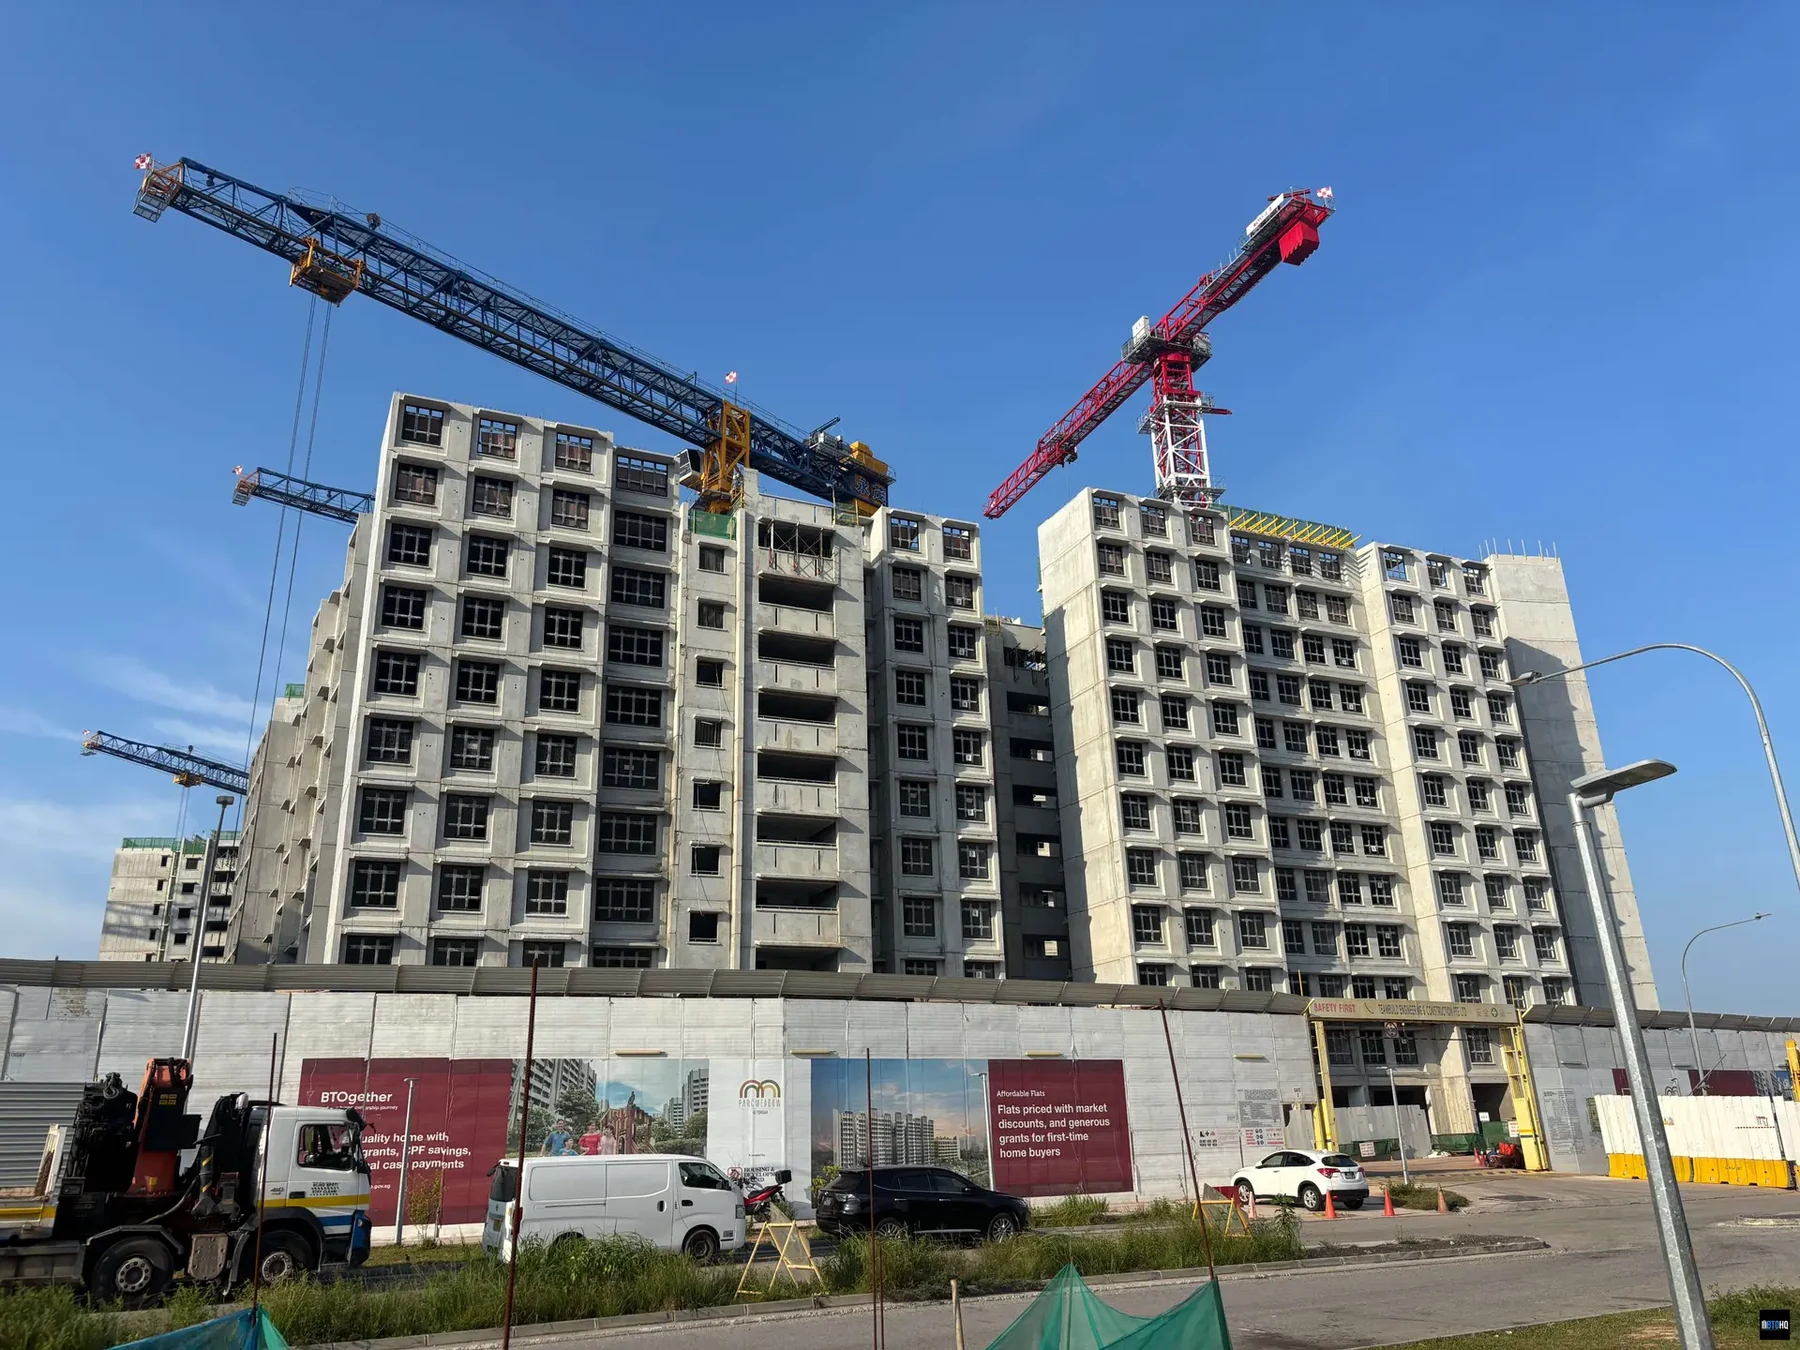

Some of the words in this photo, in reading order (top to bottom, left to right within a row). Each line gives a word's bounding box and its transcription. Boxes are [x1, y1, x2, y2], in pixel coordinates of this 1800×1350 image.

[1313, 1002, 1337, 1013] SAFETY
[1340, 1003, 1356, 1013] FIRST
[320, 1091, 393, 1105] BTOgether
[997, 1105, 1021, 1115] Flats
[1023, 1104, 1052, 1116] priced
[1054, 1103, 1074, 1114] with
[1076, 1103, 1108, 1113] market
[998, 1119, 1047, 1129] discounts,
[1049, 1118, 1067, 1128] and
[1068, 1118, 1110, 1129] generous
[362, 1133, 390, 1145] uality
[426, 1131, 449, 1142] with
[999, 1133, 1030, 1146] grants
[1031, 1132, 1045, 1143] for
[1047, 1131, 1089, 1142] first-time
[362, 1147, 399, 1158] grants,
[428, 1146, 471, 1157] savings,
[999, 1148, 1027, 1158] home
[1029, 1147, 1061, 1159] buyers
[383, 1161, 409, 1169] cas
[411, 1159, 465, 1170] payments
